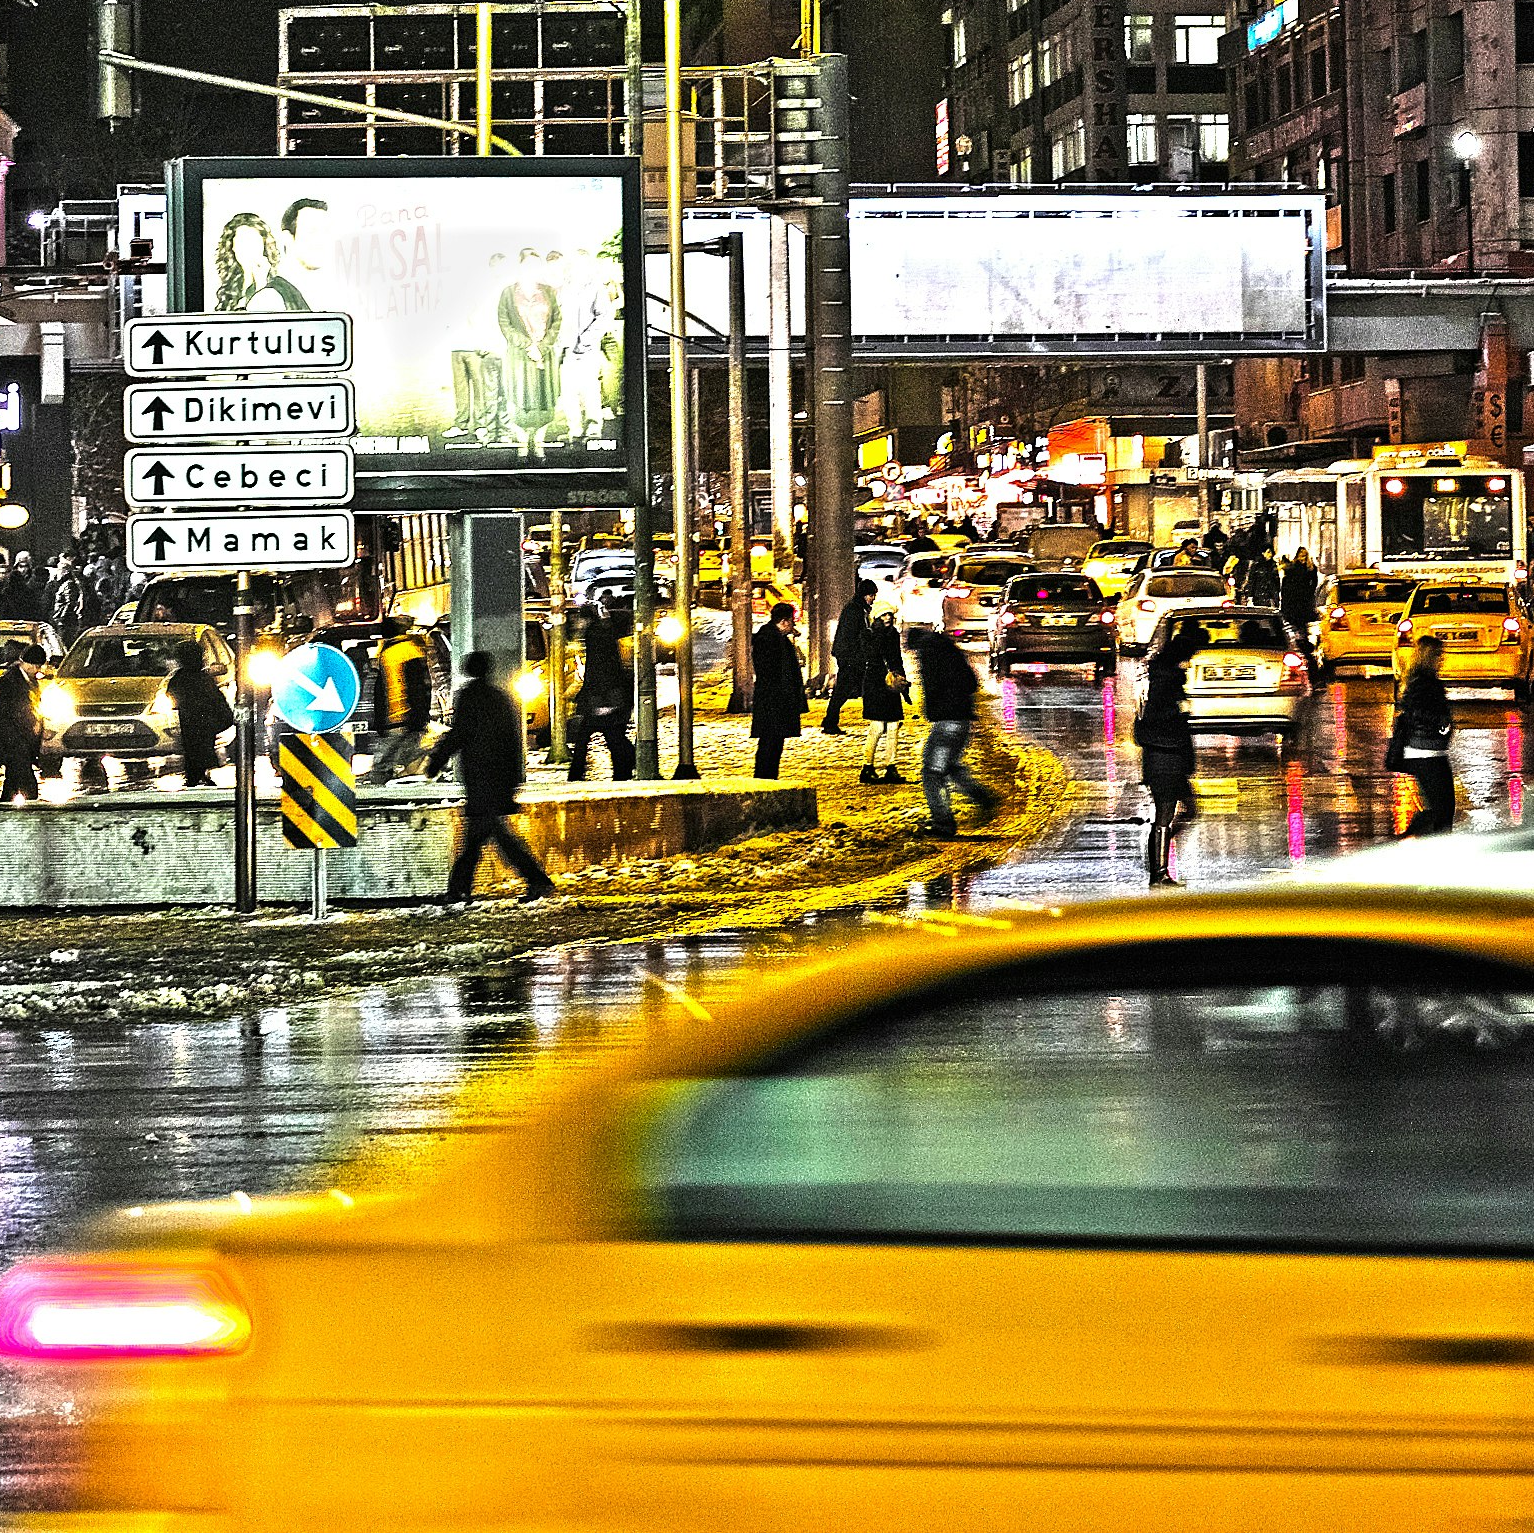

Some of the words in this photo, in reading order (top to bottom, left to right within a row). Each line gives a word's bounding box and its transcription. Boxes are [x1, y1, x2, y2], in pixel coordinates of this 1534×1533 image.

[357, 204, 429, 228] Bana
[335, 222, 453, 286] MASAL
[185, 328, 337, 357] Kurtuluş
[185, 394, 336, 423] Dikimevi
[185, 463, 327, 489] Cebeci
[187, 525, 336, 553] Mamak
